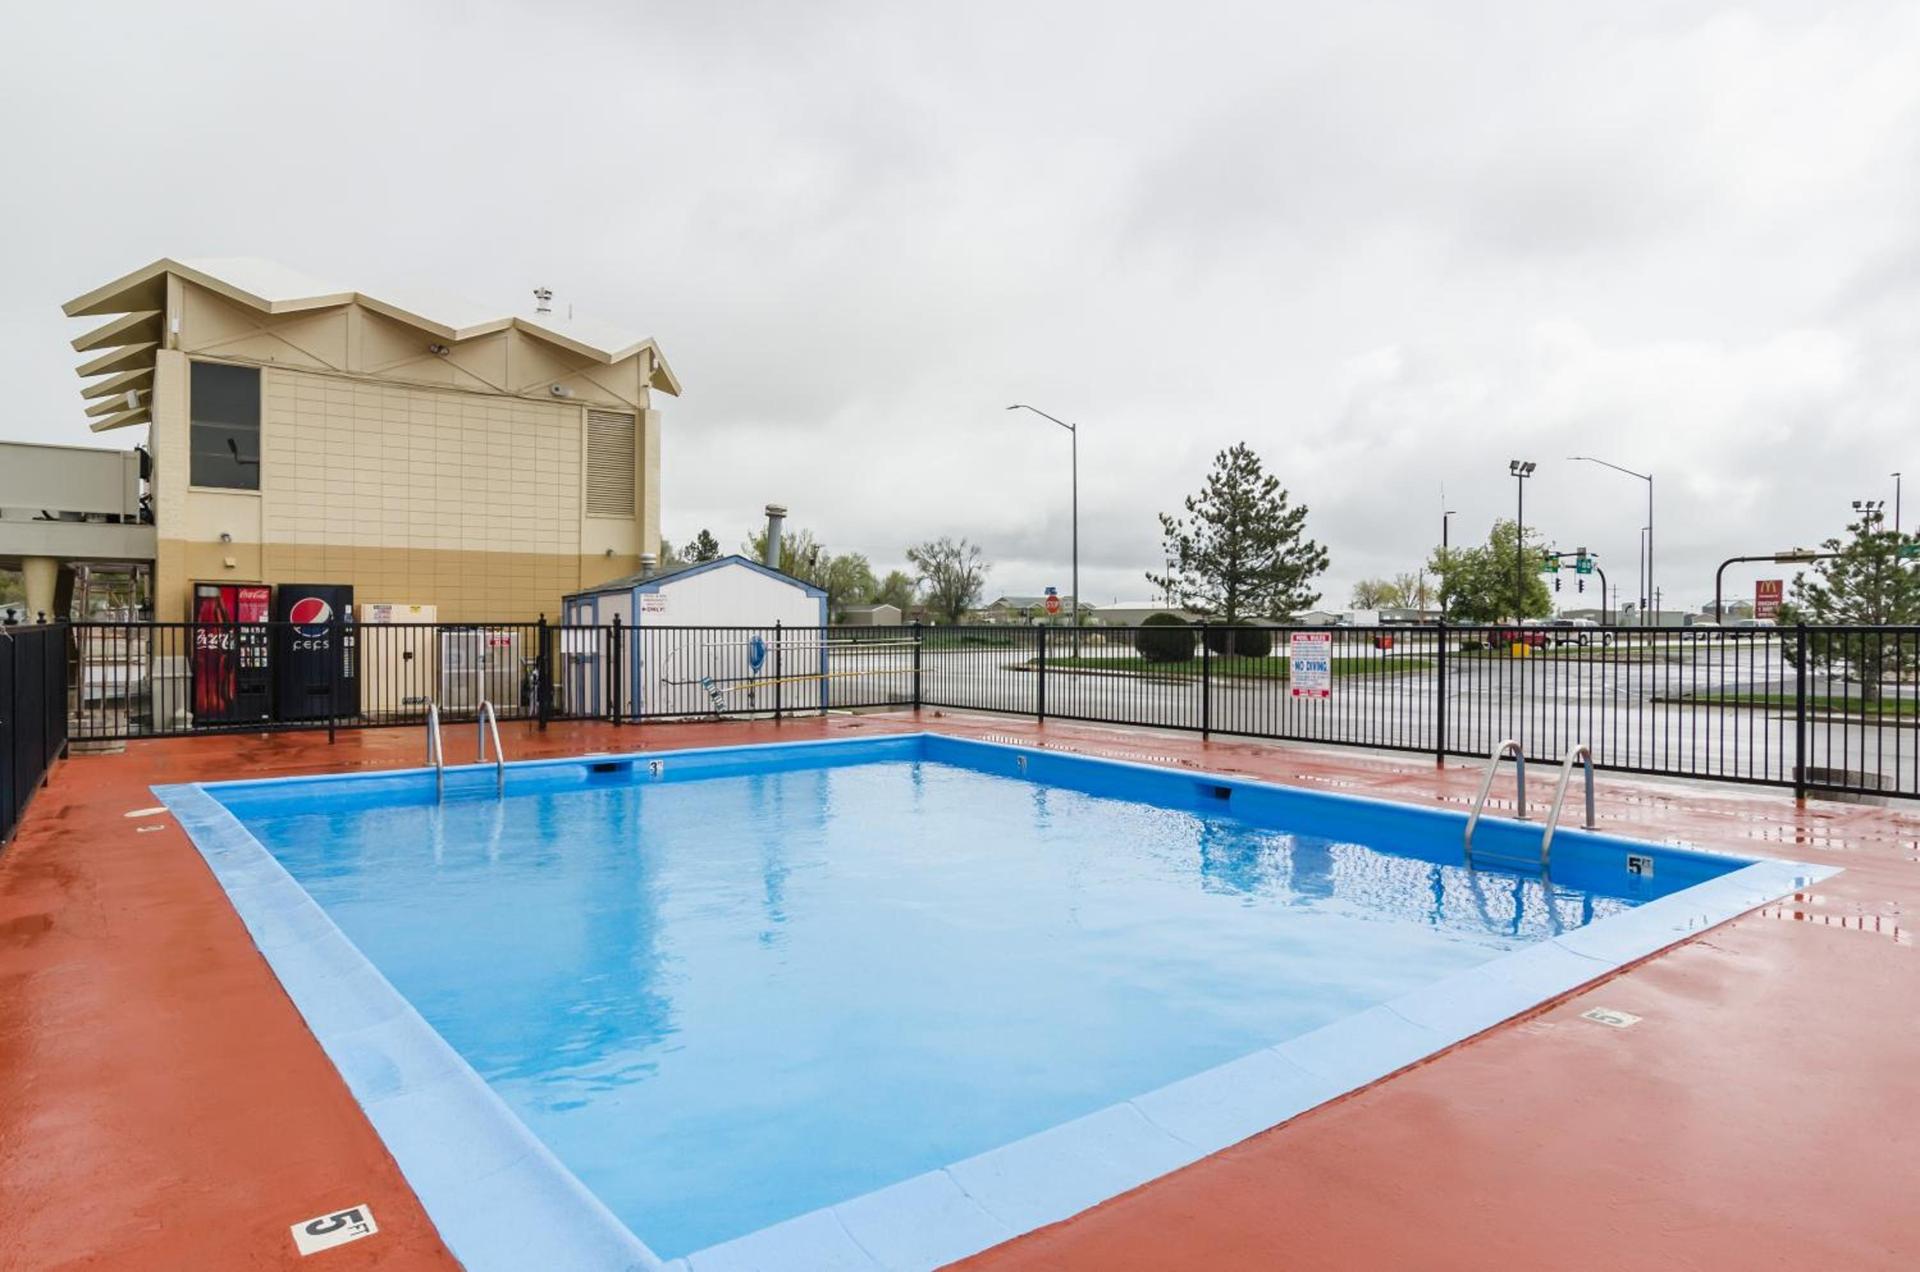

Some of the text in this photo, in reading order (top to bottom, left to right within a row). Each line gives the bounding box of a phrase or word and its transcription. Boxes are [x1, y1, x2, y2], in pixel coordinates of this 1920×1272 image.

[1294, 660, 1305, 671] NO
[1629, 856, 1642, 874] 5
[305, 1209, 364, 1235] 5
